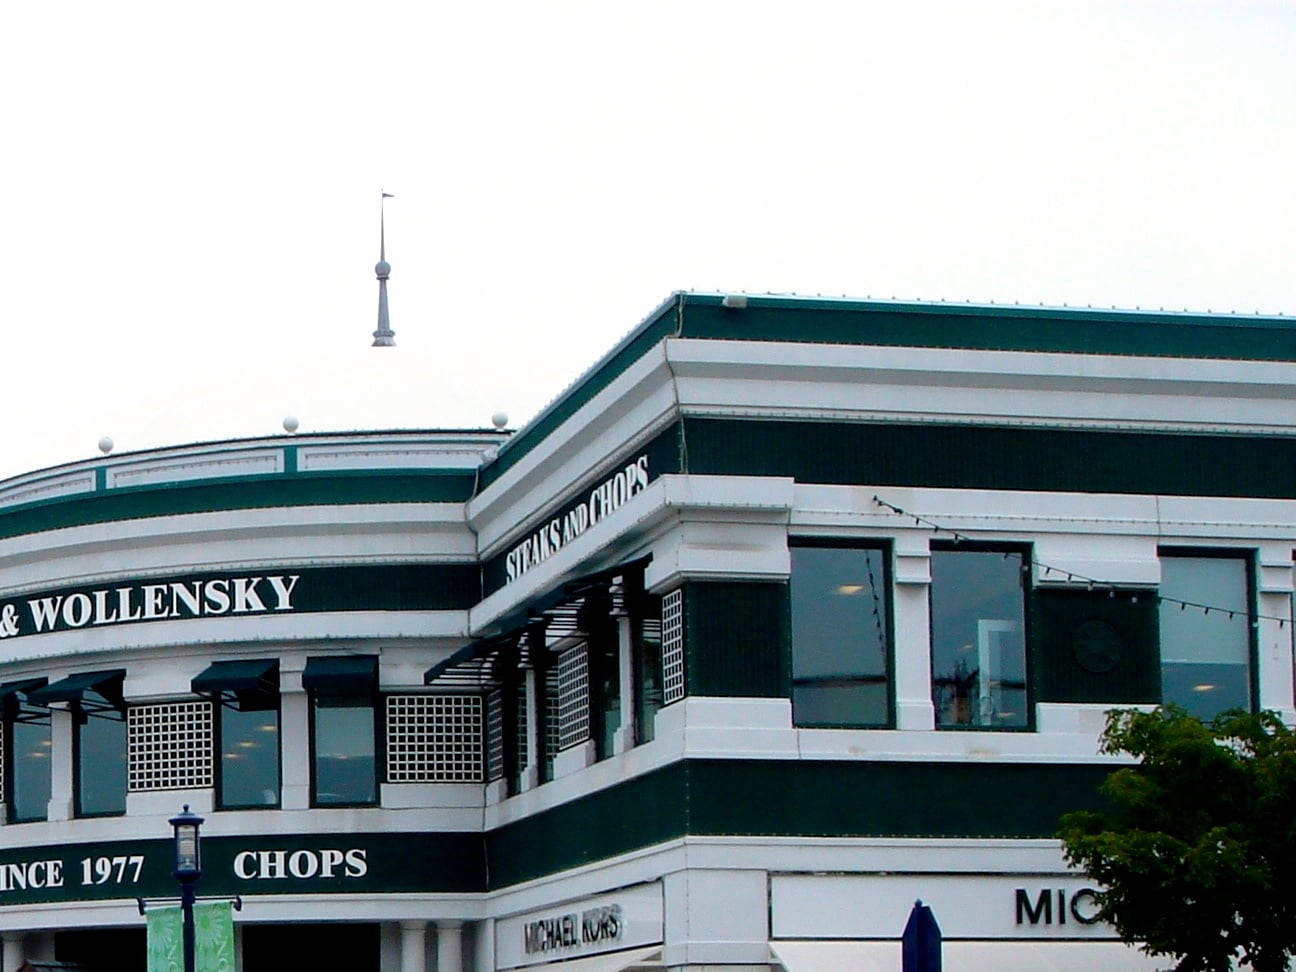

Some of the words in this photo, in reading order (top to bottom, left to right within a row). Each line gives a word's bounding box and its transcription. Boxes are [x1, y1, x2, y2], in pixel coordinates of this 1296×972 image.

[505, 517, 562, 585] STEAKS
[562, 502, 589, 546] AND
[589, 453, 649, 527] CHOPS
[27, 574, 301, 633] WOLLENSKY
[80, 855, 145, 887] 1977
[233, 848, 368, 882] CHOPS
[524, 914, 578, 954] MICHAEL
[582, 905, 621, 943] KORS
